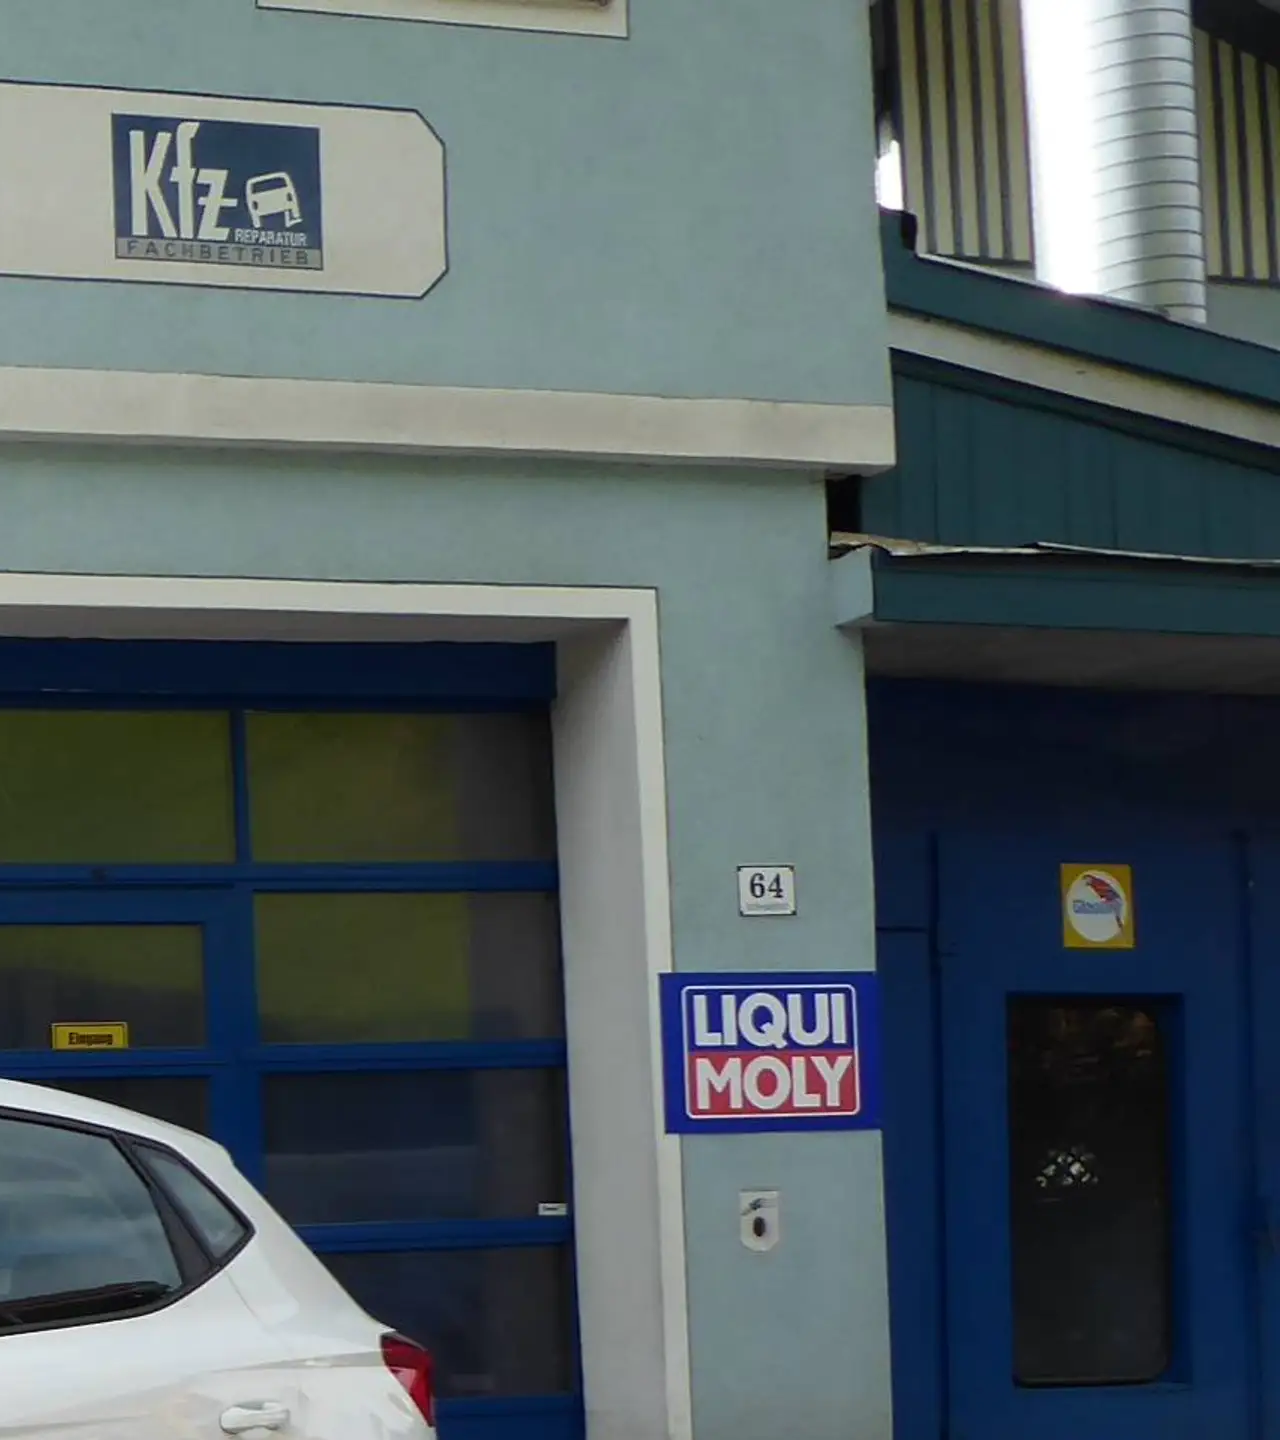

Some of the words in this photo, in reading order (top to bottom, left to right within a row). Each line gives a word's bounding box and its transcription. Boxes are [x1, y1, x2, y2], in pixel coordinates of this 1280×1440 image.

[129, 121, 238, 240] Kfz
[127, 241, 309, 265] FACHBETRIEB
[235, 228, 308, 246] REPARATUR
[749, 872, 784, 899] 64
[692, 992, 847, 1049] LIQUI
[695, 1054, 853, 1111] MOLY
